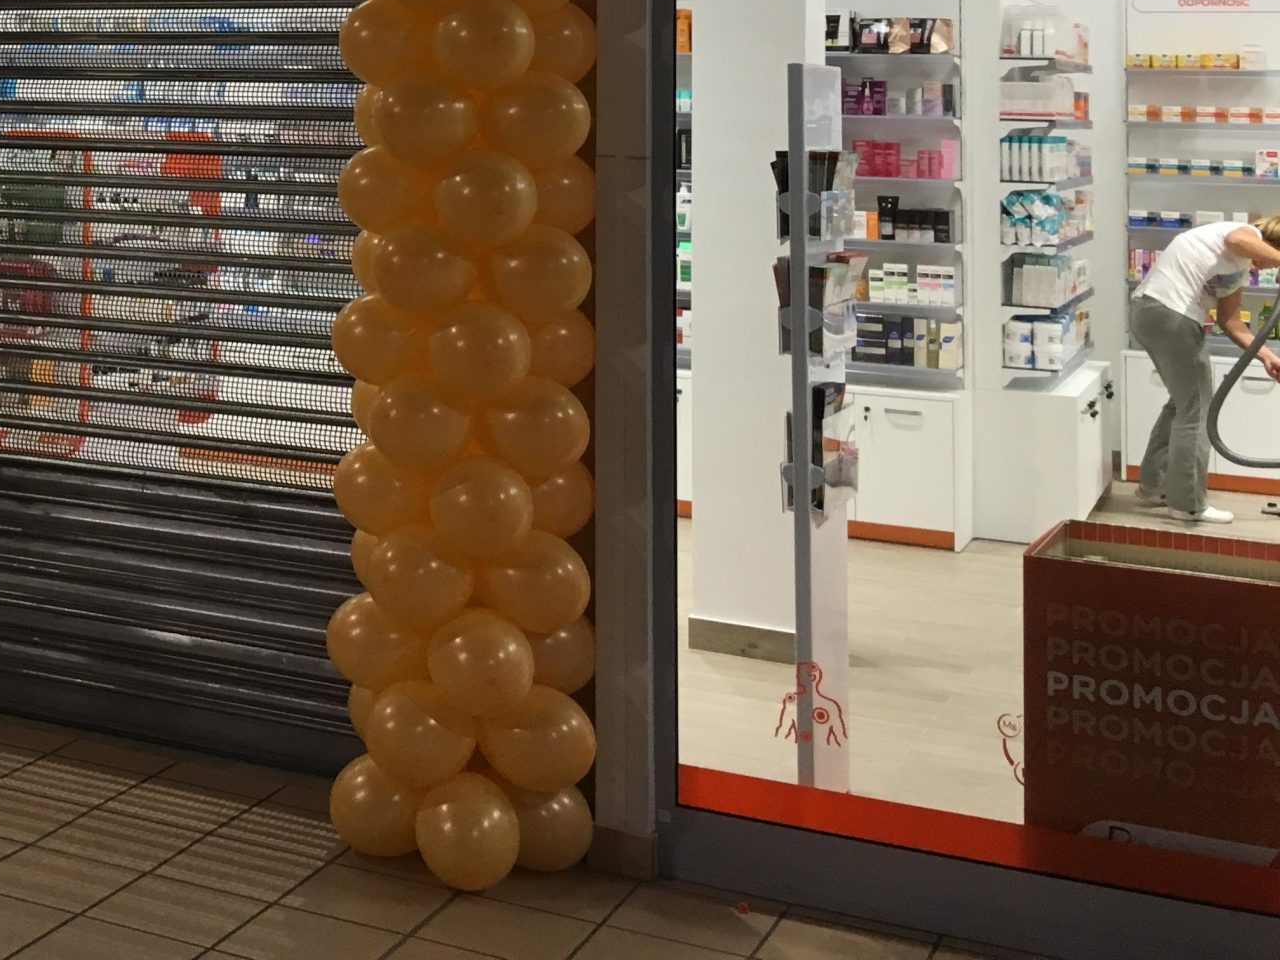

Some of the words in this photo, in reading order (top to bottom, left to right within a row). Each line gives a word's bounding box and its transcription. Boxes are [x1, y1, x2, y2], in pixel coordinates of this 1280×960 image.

[1046, 636, 1280, 695] PROMOCJA
[1046, 670, 1280, 731] PROMOCJA
[1046, 705, 1280, 767] PROMOCJA
